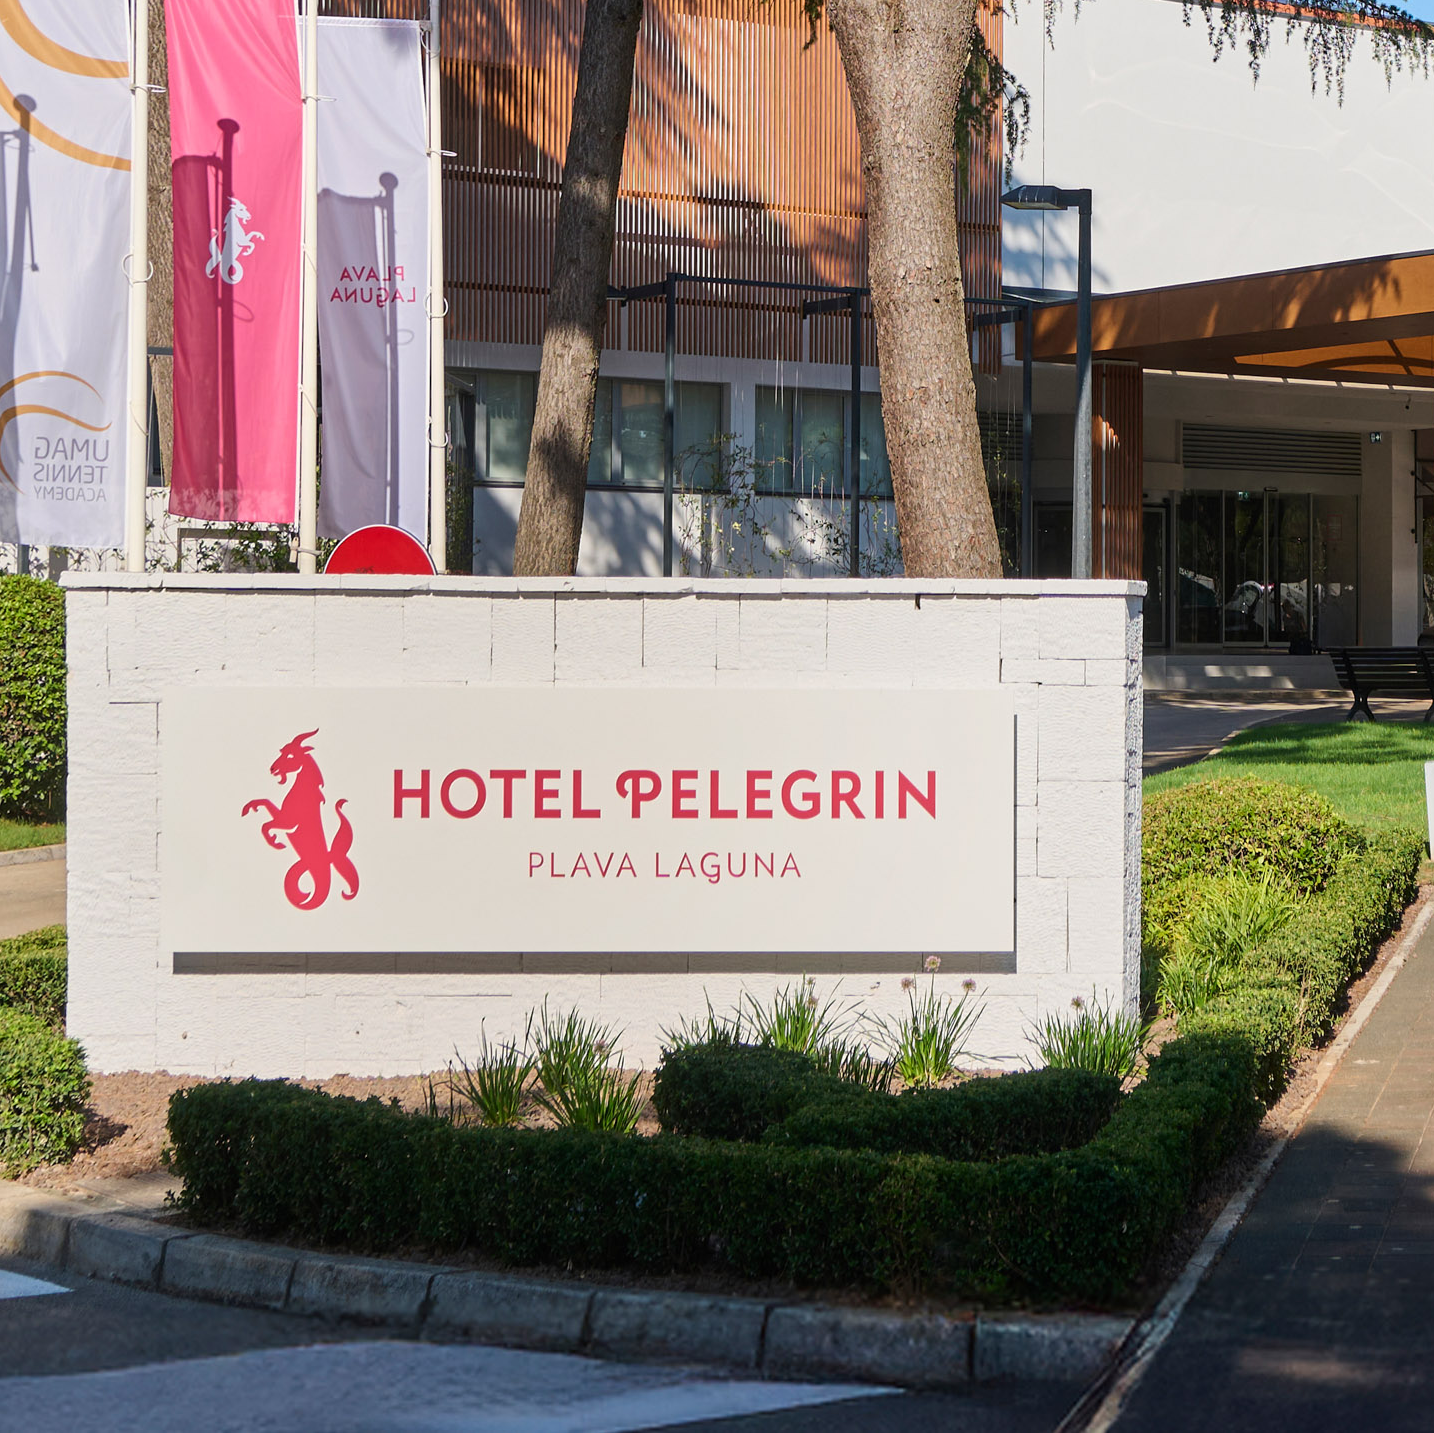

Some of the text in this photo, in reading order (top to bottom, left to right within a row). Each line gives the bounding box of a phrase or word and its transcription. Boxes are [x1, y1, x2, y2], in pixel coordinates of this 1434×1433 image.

[393, 768, 937, 820] HOTEL PELEGRIN
[528, 852, 802, 884] PLAVA LAGUNA
